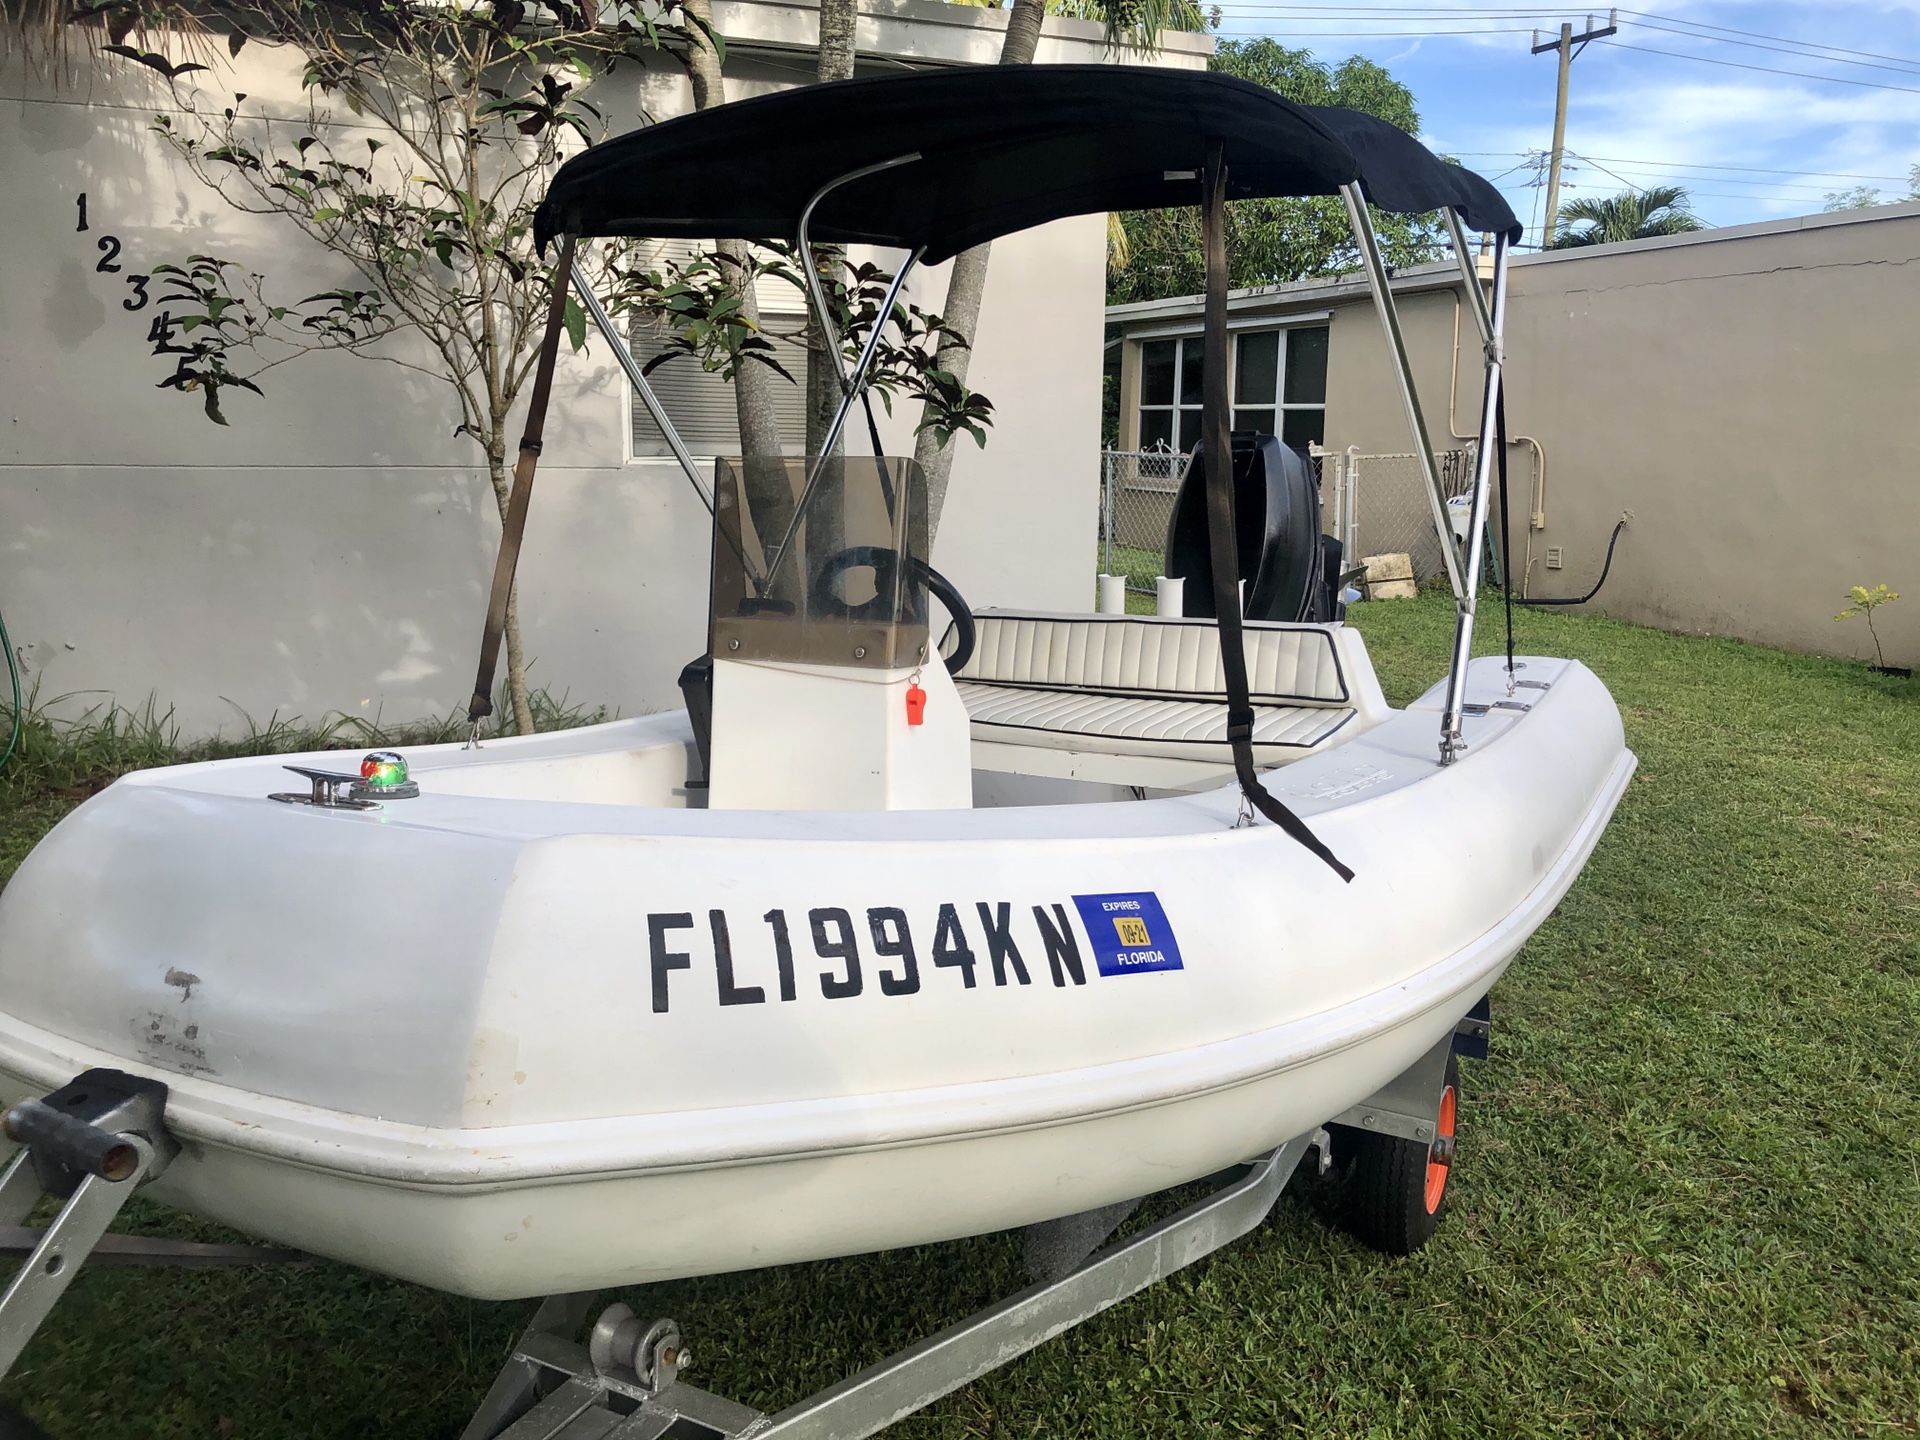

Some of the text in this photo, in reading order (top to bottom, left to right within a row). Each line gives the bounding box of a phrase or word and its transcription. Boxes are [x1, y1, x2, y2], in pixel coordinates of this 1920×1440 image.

[1102, 901, 1141, 912] EXPIRES
[1122, 924, 1149, 943] 09-21
[1117, 950, 1165, 965] FLORIDA
